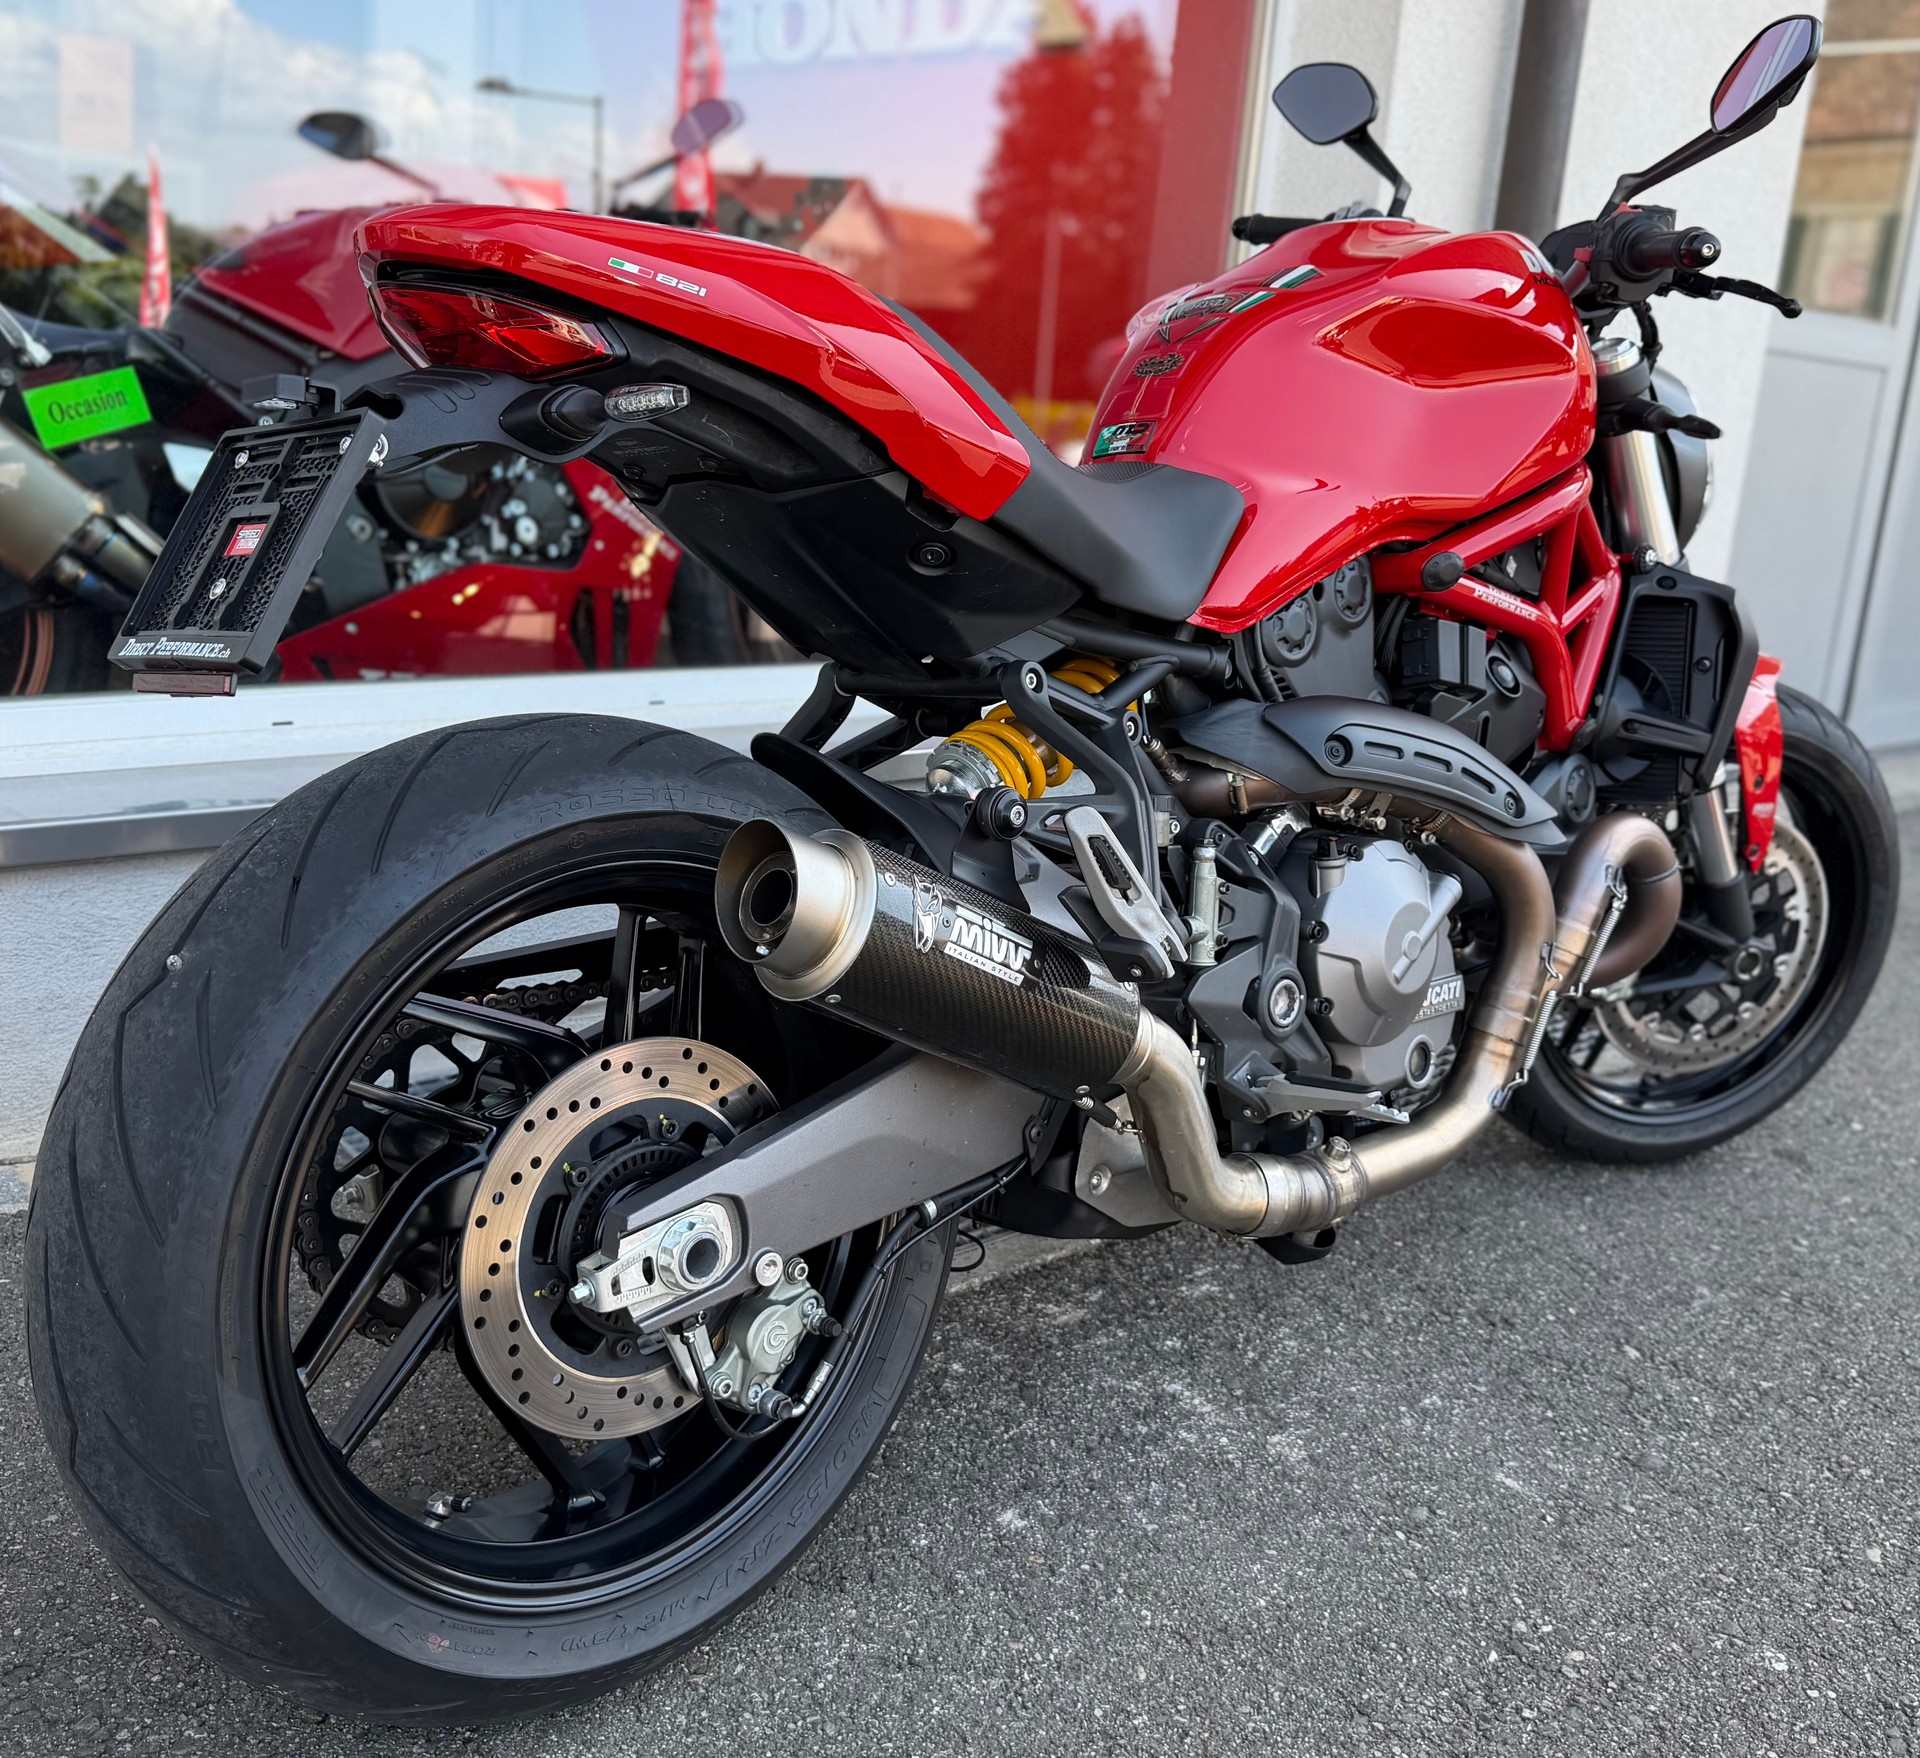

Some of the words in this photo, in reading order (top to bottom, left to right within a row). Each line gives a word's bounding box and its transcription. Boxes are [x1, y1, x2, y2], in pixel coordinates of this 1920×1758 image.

[656, 272, 707, 297] 821
[47, 389, 128, 424] Occasion
[118, 638, 155, 656] DIRECT
[948, 946, 987, 968] ITALIAN
[990, 965, 1020, 983] STYLE
